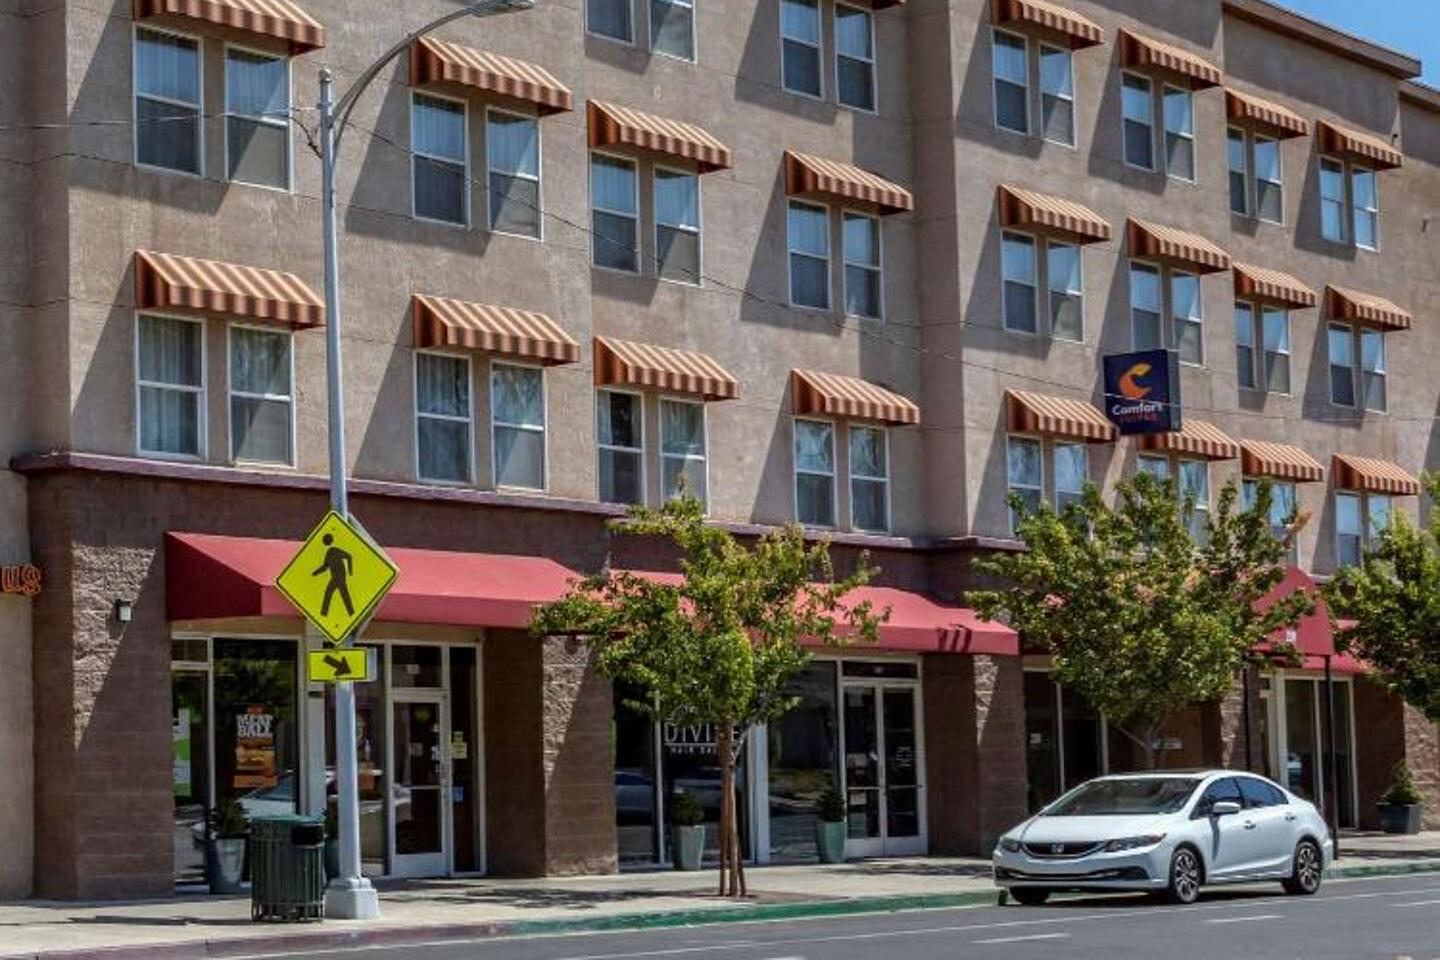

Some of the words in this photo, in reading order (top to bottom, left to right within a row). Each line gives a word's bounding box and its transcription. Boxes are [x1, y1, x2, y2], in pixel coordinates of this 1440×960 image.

[1111, 400, 1163, 416] Comfort
[236, 713, 274, 726] MEAT
[237, 724, 273, 738] BALL
[664, 722, 739, 743] DIVIE
